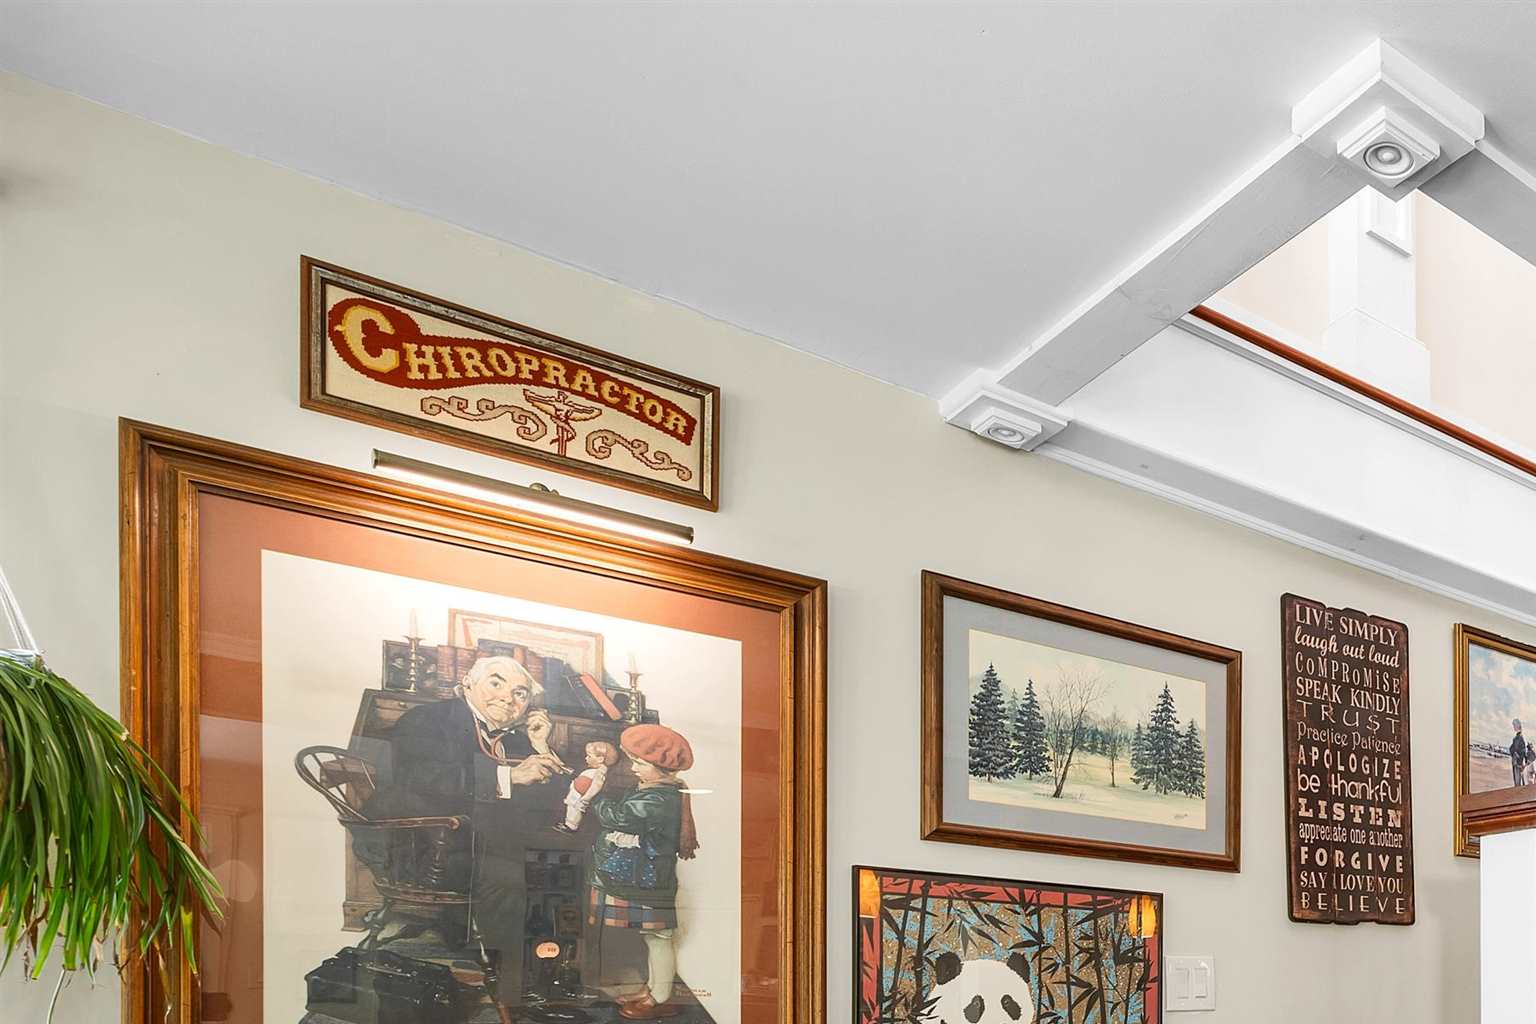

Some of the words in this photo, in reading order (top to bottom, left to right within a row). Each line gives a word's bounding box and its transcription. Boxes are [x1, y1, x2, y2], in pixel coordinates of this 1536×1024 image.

[1295, 604, 1334, 631] LIVE
[1339, 616, 1398, 646] SIMPLY
[1294, 626, 1339, 656] laugh
[1342, 642, 1366, 659] out
[1368, 644, 1400, 668] loud
[1296, 676, 1342, 704] SPEAK
[1350, 687, 1400, 715] KINDLY
[1296, 699, 1400, 735] TRUST
[1298, 744, 1401, 780] APOLOGIZE
[1297, 768, 1321, 793] be
[1328, 773, 1402, 805] thankful
[1298, 798, 1402, 828] LISTEN
[1299, 822, 1348, 843] appreciate
[1350, 828, 1366, 845] one
[1300, 846, 1404, 873] FORGIVE
[1300, 870, 1328, 889] SAY
[1340, 873, 1375, 893] LOVE
[1377, 876, 1403, 895] YOU
[1300, 892, 1405, 914] BELIEVE
